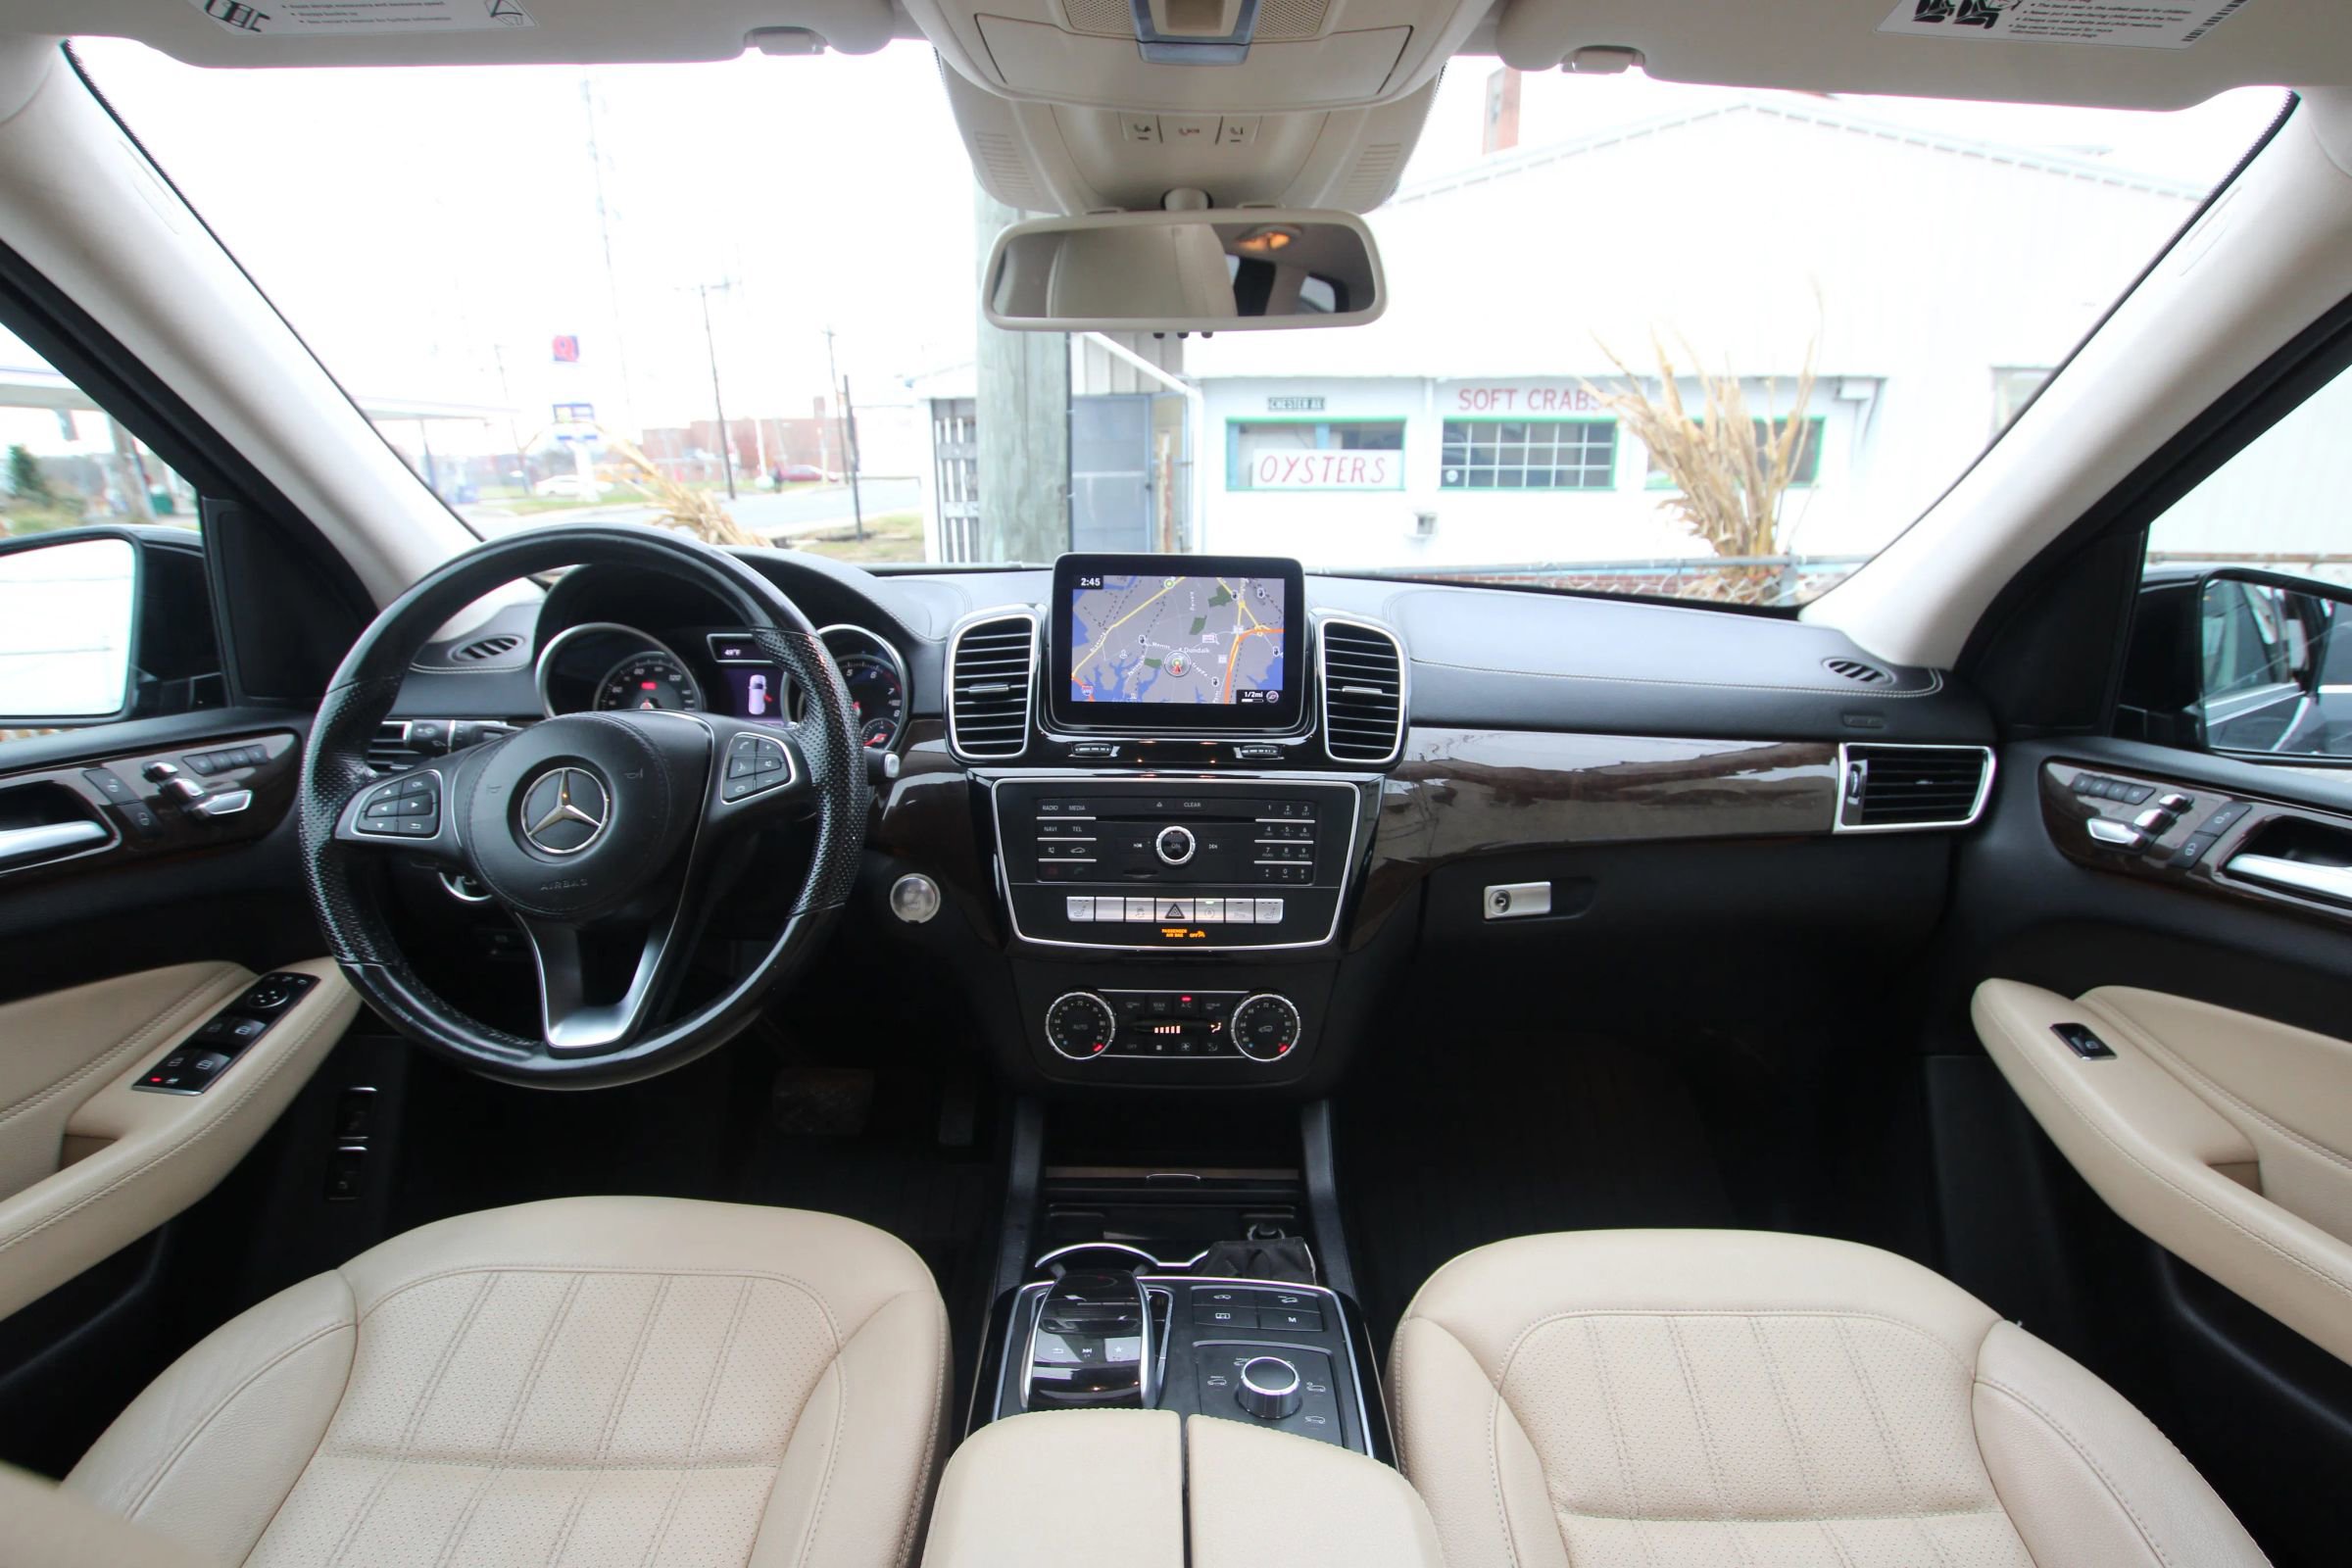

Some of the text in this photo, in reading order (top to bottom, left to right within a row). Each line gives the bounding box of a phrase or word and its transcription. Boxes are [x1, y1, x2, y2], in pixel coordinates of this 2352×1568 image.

[1458, 388, 1518, 411] SOFT
[1259, 455, 1387, 484] OYSTERS
[1081, 578, 1101, 587] 2:45
[869, 670, 877, 679] 6
